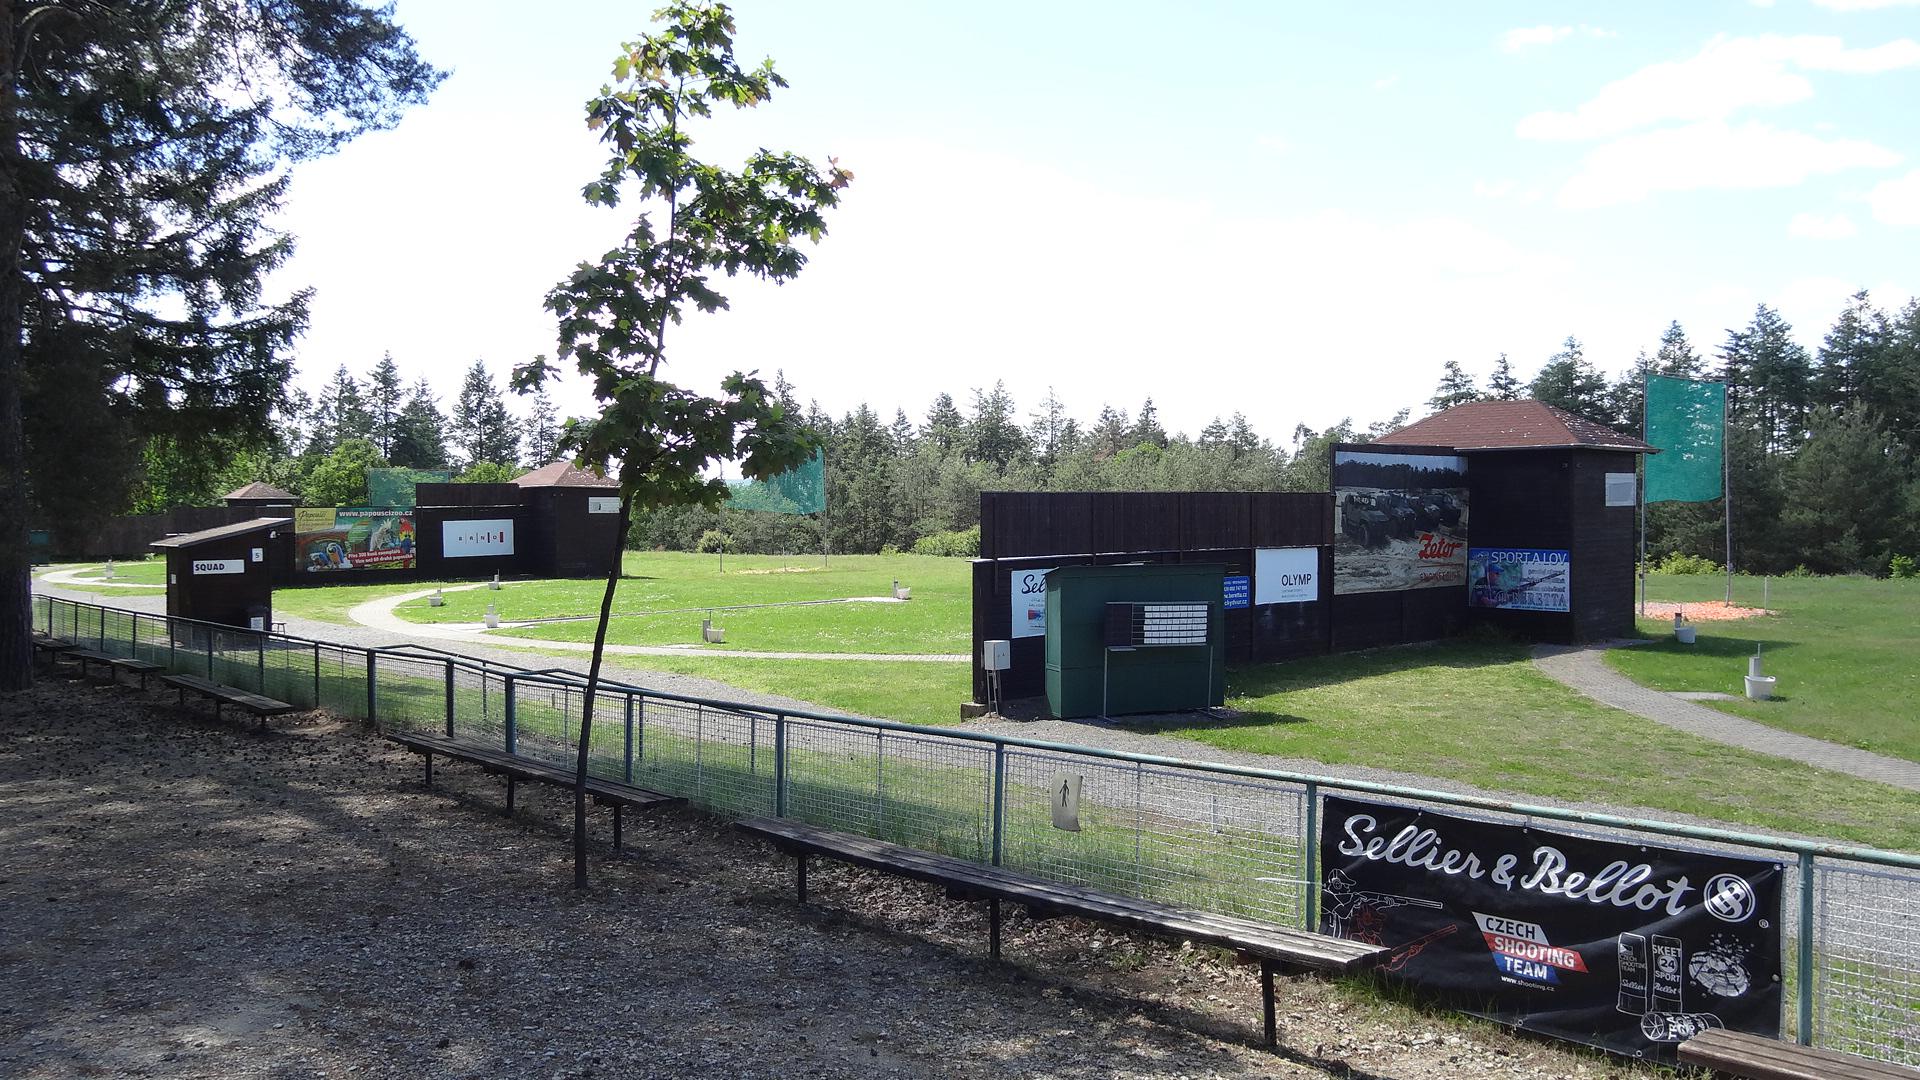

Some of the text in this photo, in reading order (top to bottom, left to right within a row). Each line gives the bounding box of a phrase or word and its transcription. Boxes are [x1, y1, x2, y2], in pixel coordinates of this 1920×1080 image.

[339, 509, 413, 518] www.papouscizoo.cz
[1418, 533, 1463, 559] Zetor
[1491, 551, 1531, 564] SPORT
[1532, 553, 1541, 565] A
[1543, 553, 1567, 566] LOV
[195, 563, 225, 571] SQUAD
[1281, 573, 1312, 586] OLYMP
[1338, 814, 1696, 916] Sellier & Bellot
[1485, 917, 1535, 940] CZECH
[1494, 936, 1575, 968] SHOOTING
[1652, 944, 1681, 958] SKEET
[1504, 956, 1547, 979] TEAM
[1660, 958, 1675, 969] 24
[1501, 975, 1555, 991] www.shooting.cz
[1655, 971, 1681, 983] SPORT
